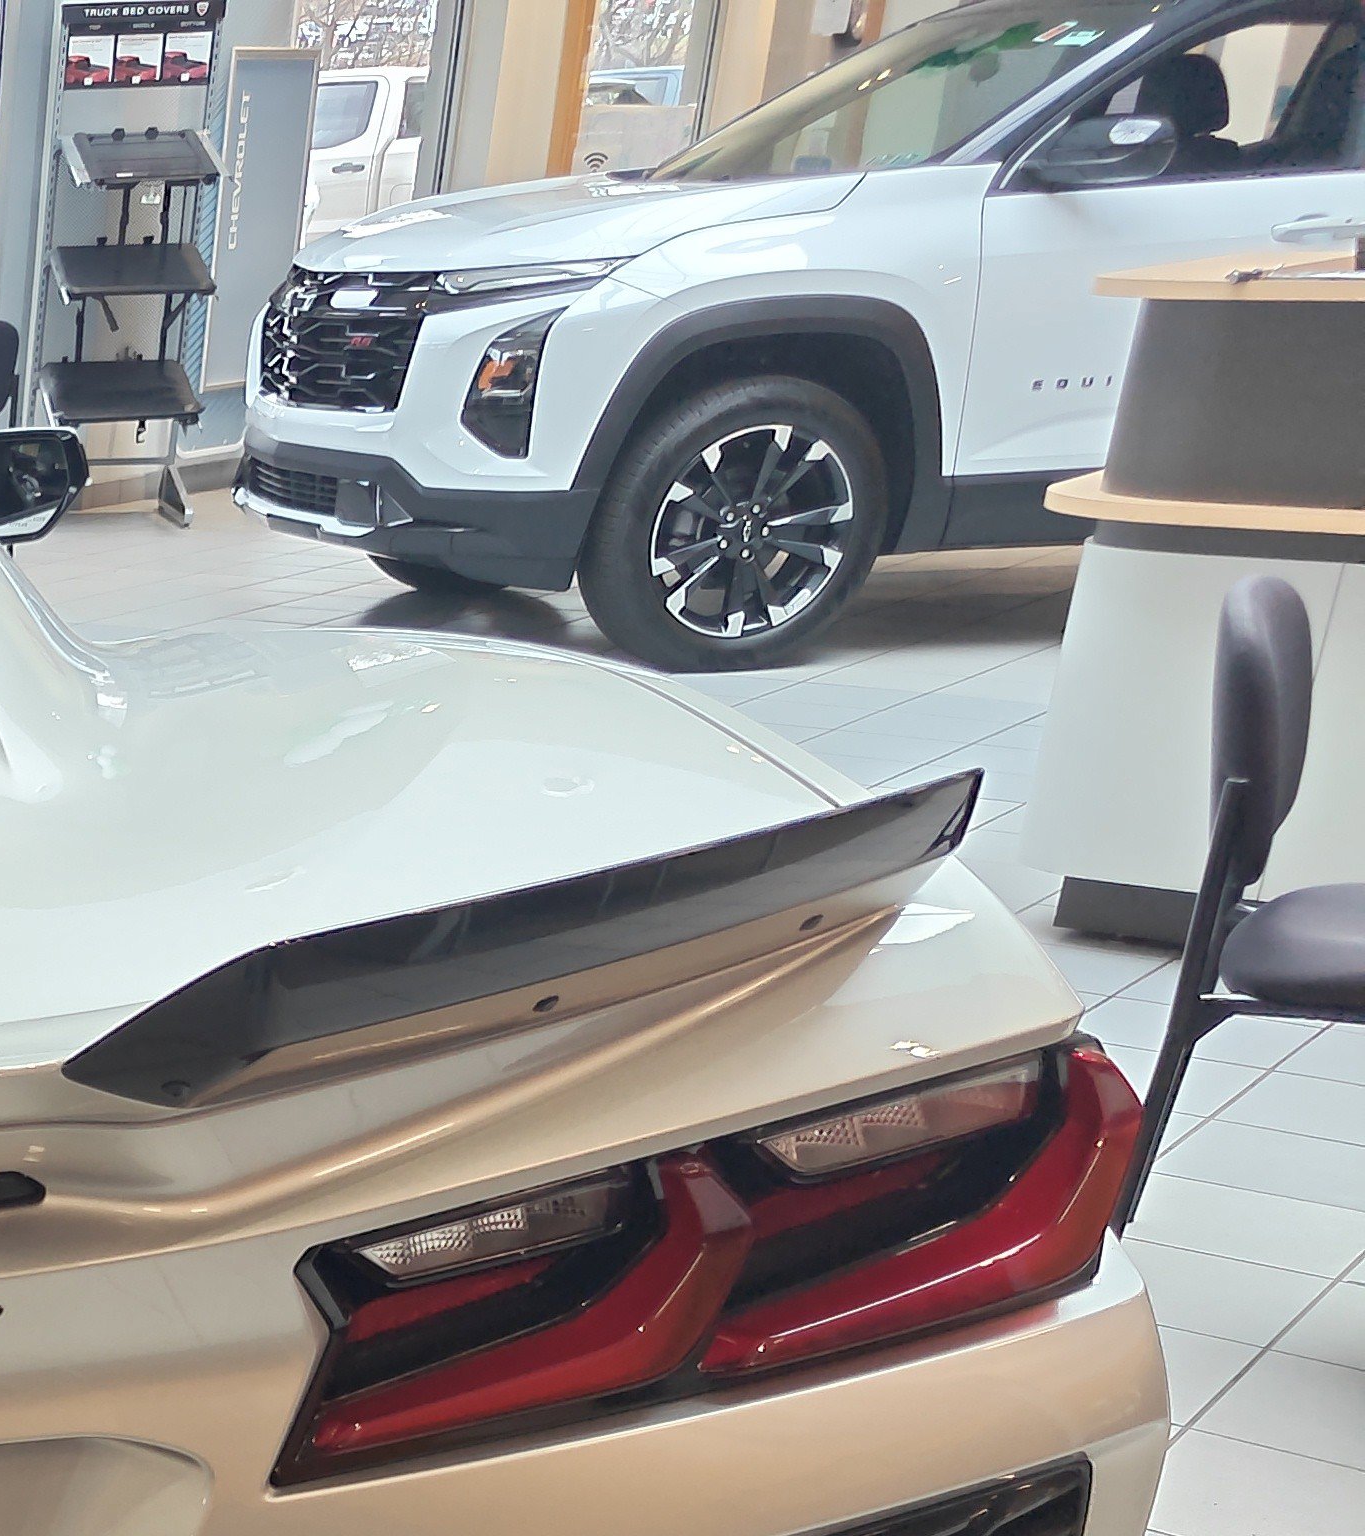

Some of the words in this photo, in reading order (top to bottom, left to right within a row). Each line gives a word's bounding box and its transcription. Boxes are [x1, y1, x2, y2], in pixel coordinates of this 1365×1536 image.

[84, 8, 118, 17] TRUCK
[122, 6, 144, 16] BED
[147, 5, 190, 15] COVERS
[228, 90, 251, 250] CHEVROLET
[1031, 375, 1113, 391] EQUI
